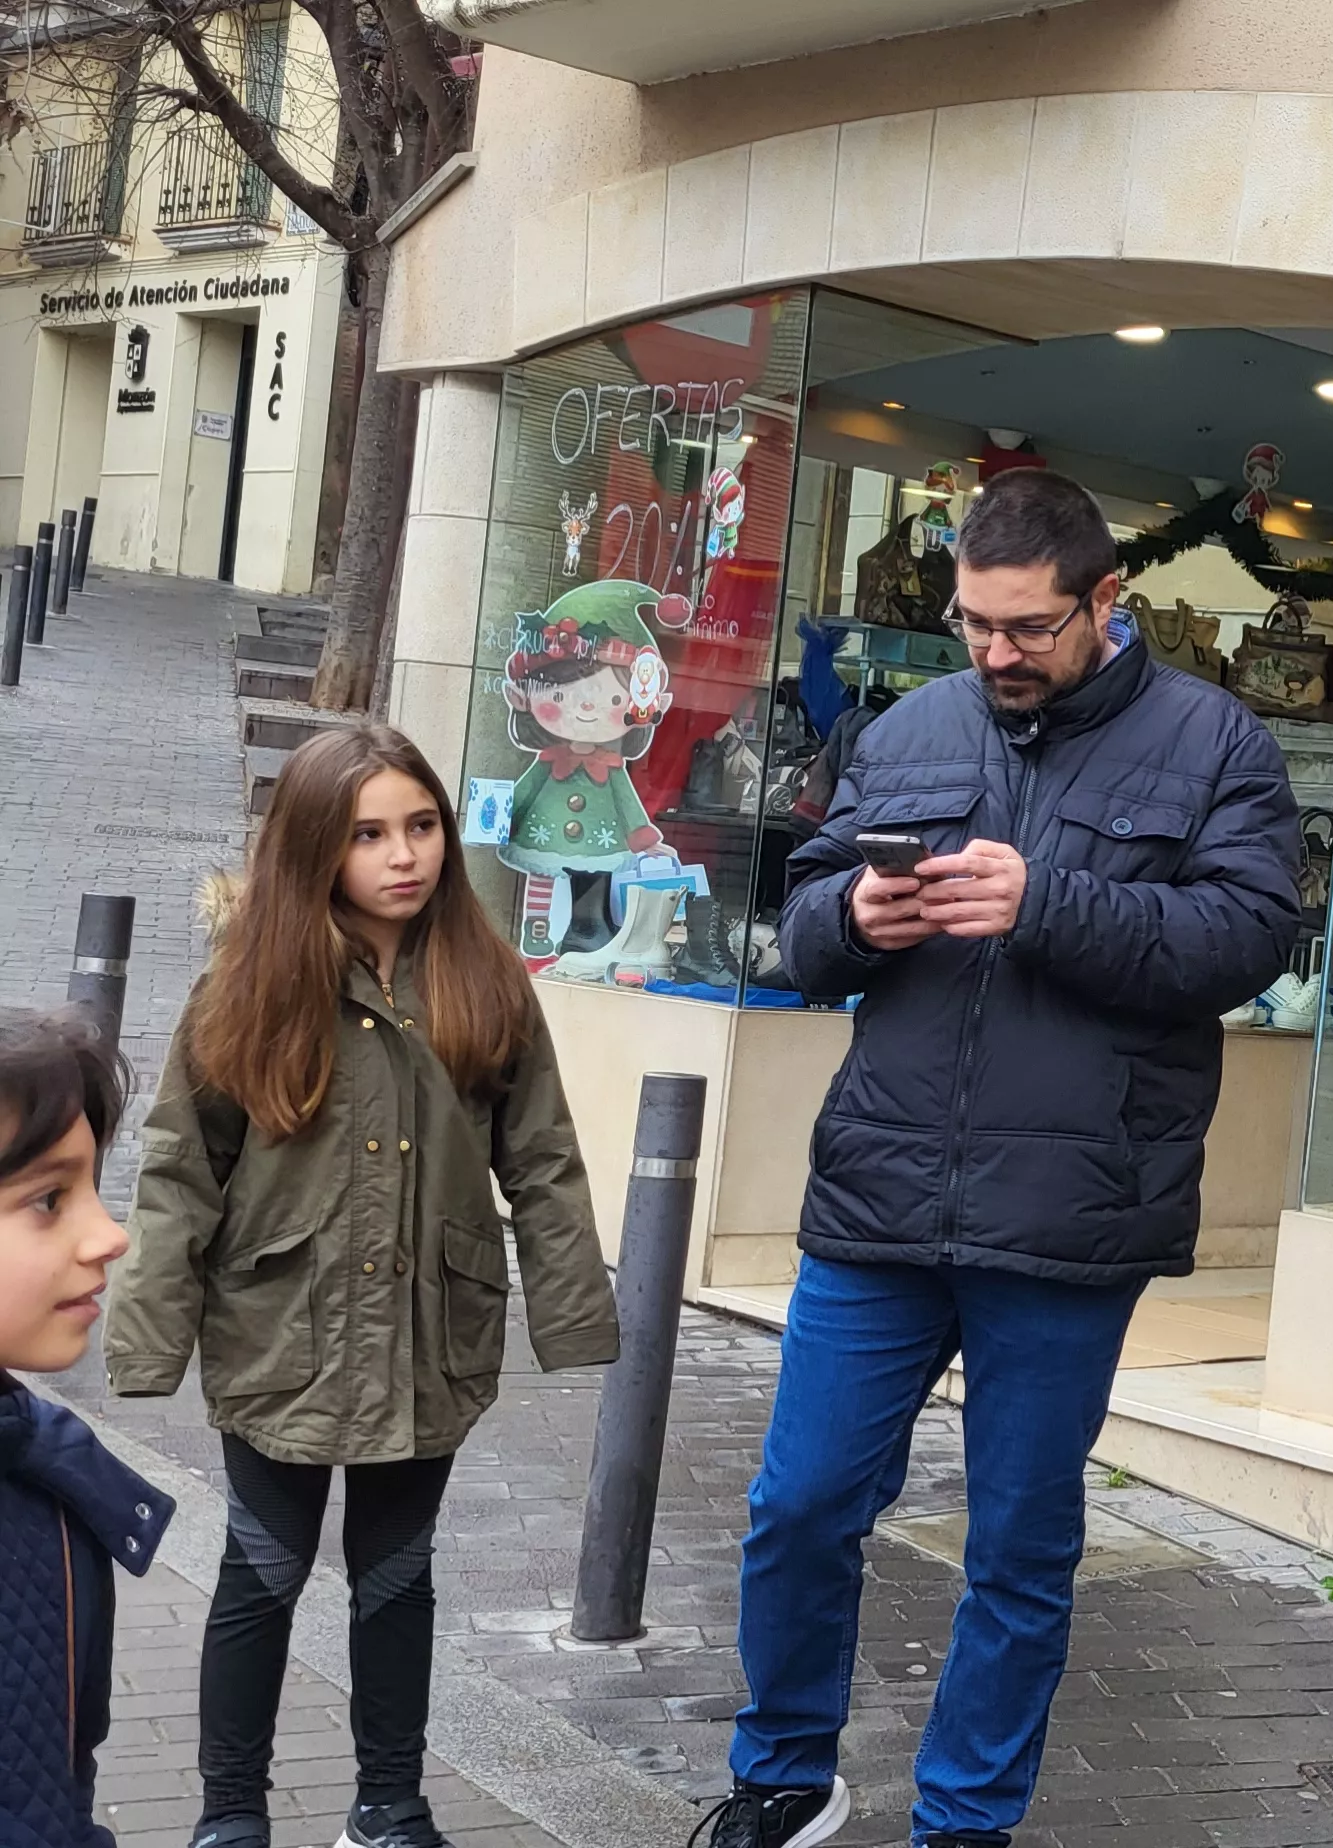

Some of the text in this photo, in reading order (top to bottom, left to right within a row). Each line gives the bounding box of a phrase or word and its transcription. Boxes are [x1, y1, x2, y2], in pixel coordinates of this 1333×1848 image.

[40, 274, 290, 314] Servicio de Atención Ciudadana
[552, 378, 745, 465] OFERTAS
[683, 615, 739, 640] mínimo
